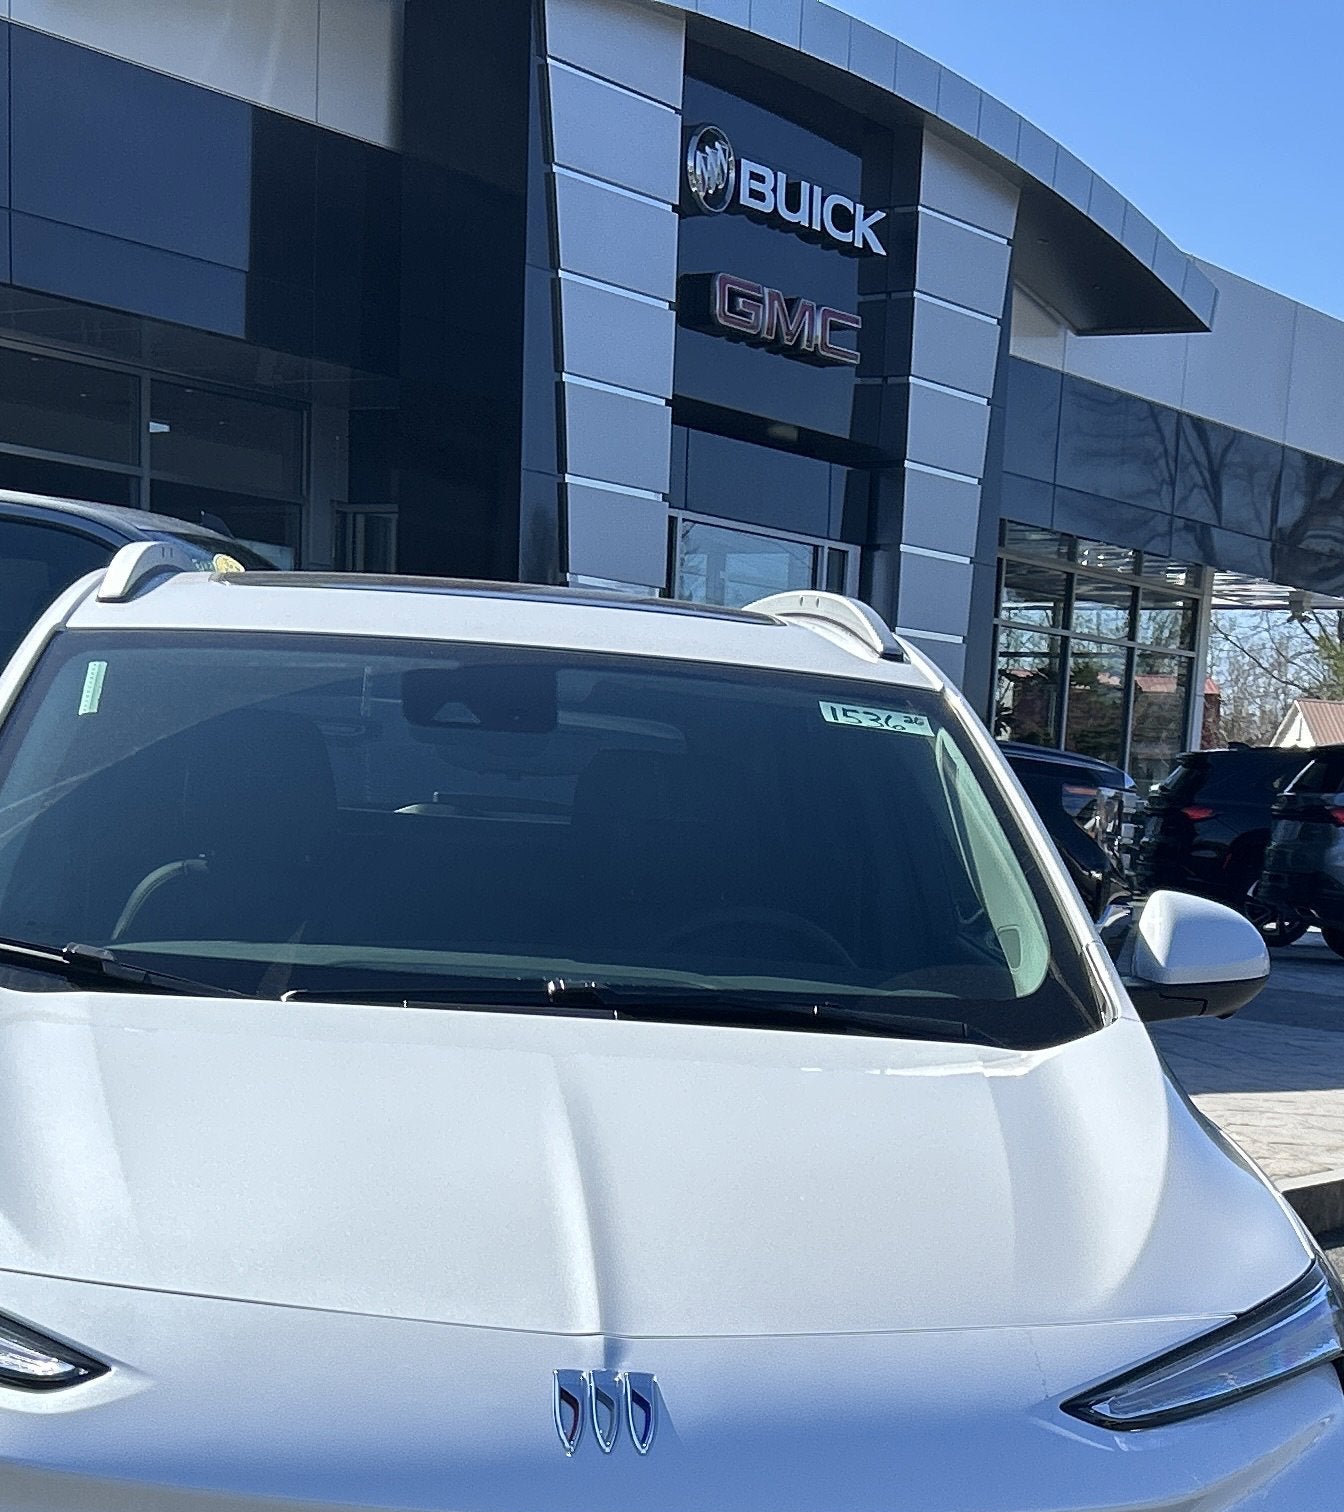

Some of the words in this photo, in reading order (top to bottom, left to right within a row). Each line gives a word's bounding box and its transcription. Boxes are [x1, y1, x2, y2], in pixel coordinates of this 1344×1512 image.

[740, 158, 887, 256] BUICK
[715, 272, 862, 364] GMC
[830, 705, 906, 731] 1536
